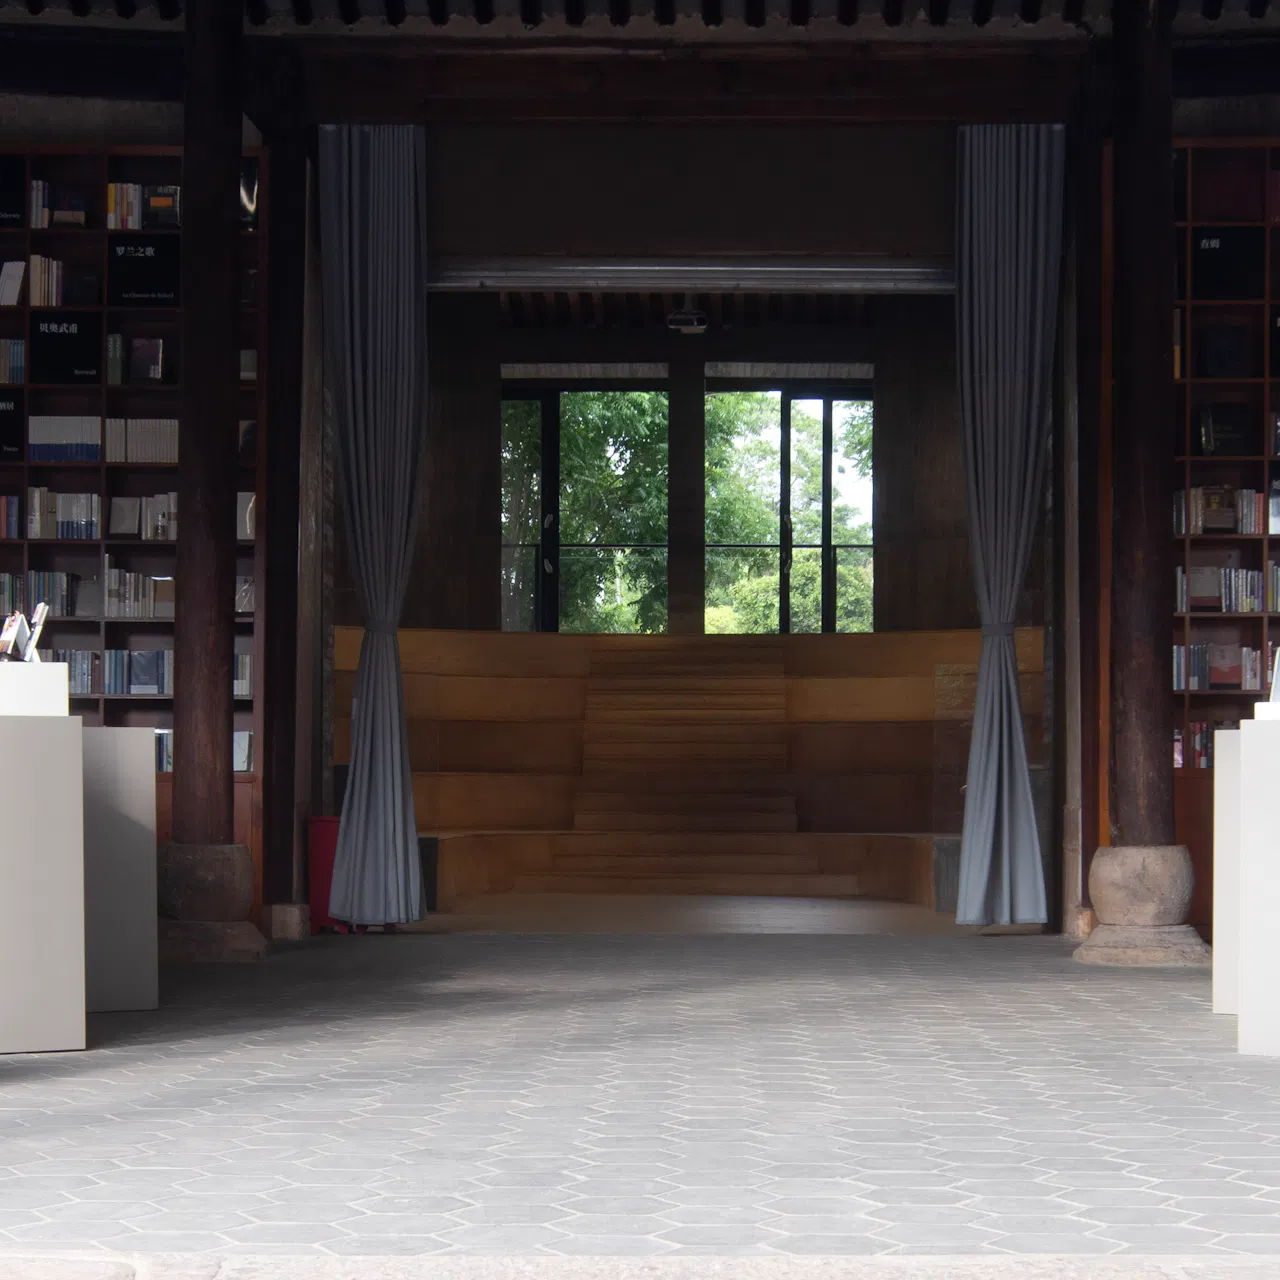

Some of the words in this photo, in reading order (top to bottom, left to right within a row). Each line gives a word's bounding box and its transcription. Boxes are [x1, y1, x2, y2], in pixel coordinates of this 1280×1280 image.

[115, 245, 156, 257] 罗兰之歌
[39, 322, 79, 334] 贝奥武甫
